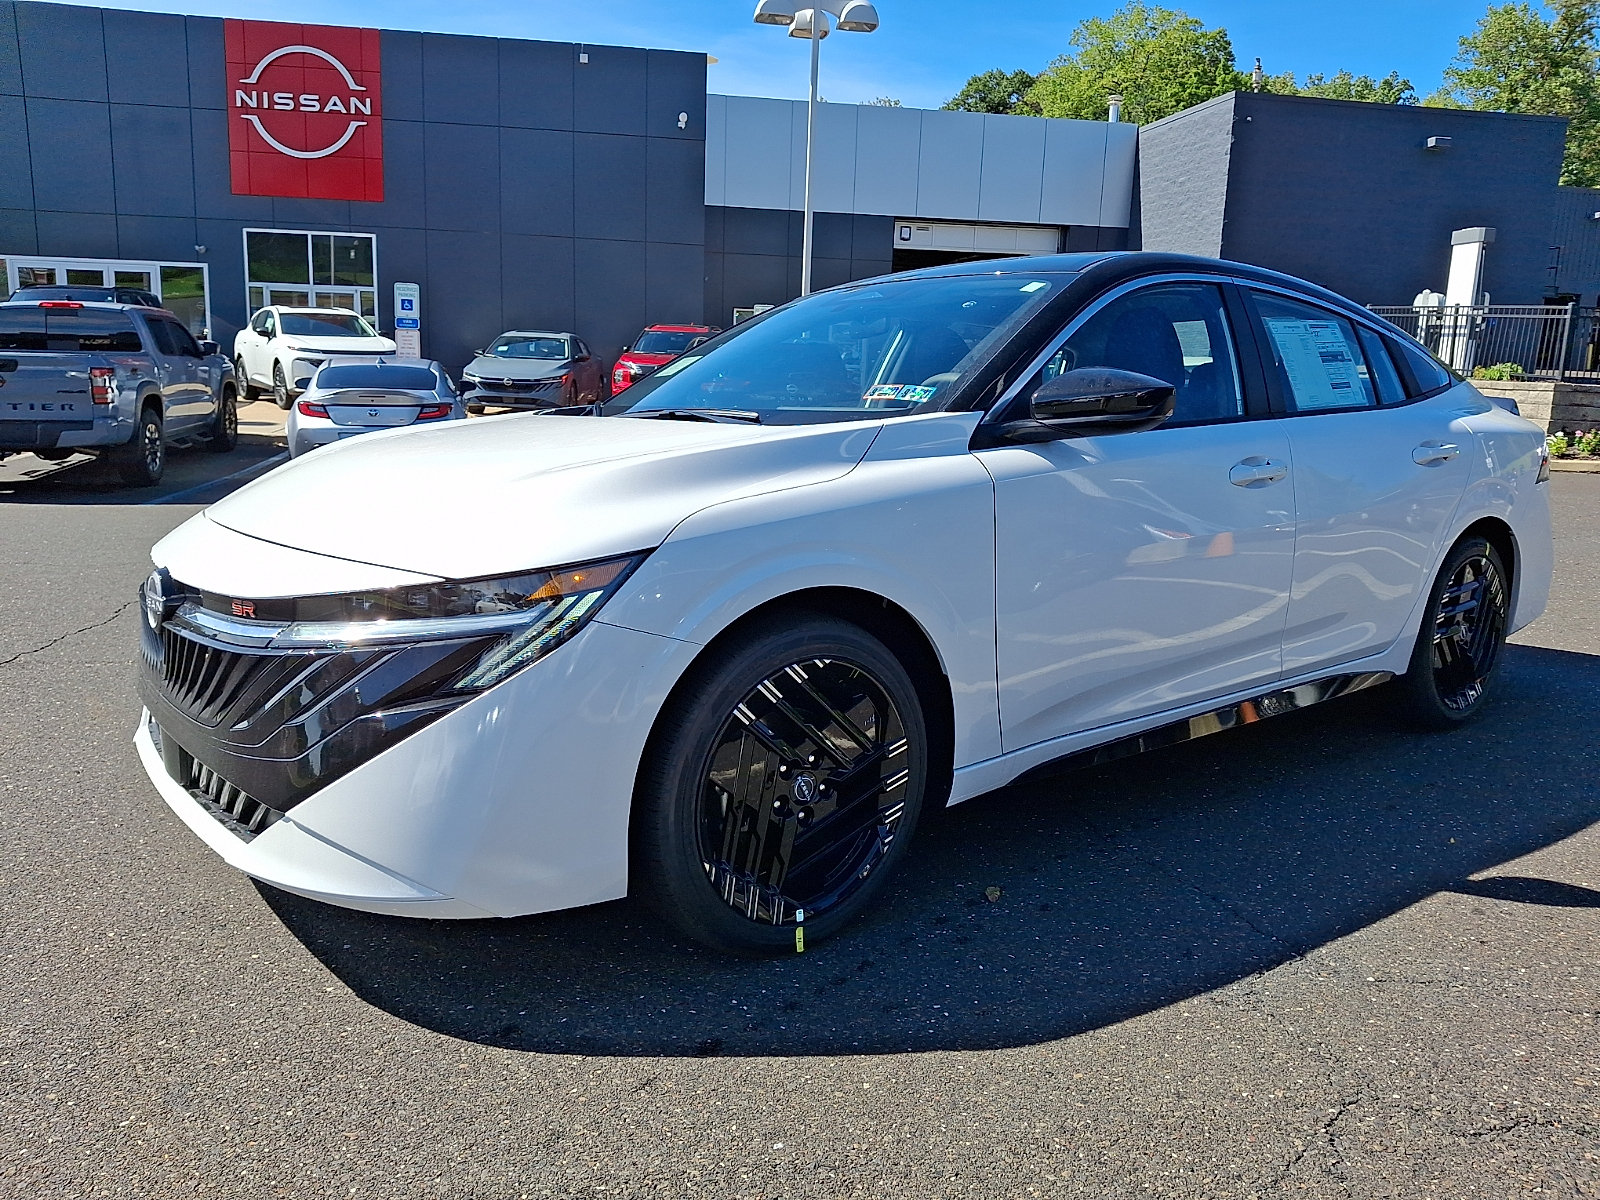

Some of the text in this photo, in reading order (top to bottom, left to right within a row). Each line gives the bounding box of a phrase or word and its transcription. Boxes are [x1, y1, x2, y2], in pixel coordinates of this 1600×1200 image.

[235, 89, 372, 115] NISSAN
[7, 402, 75, 411] TIER
[231, 600, 256, 618] SR
